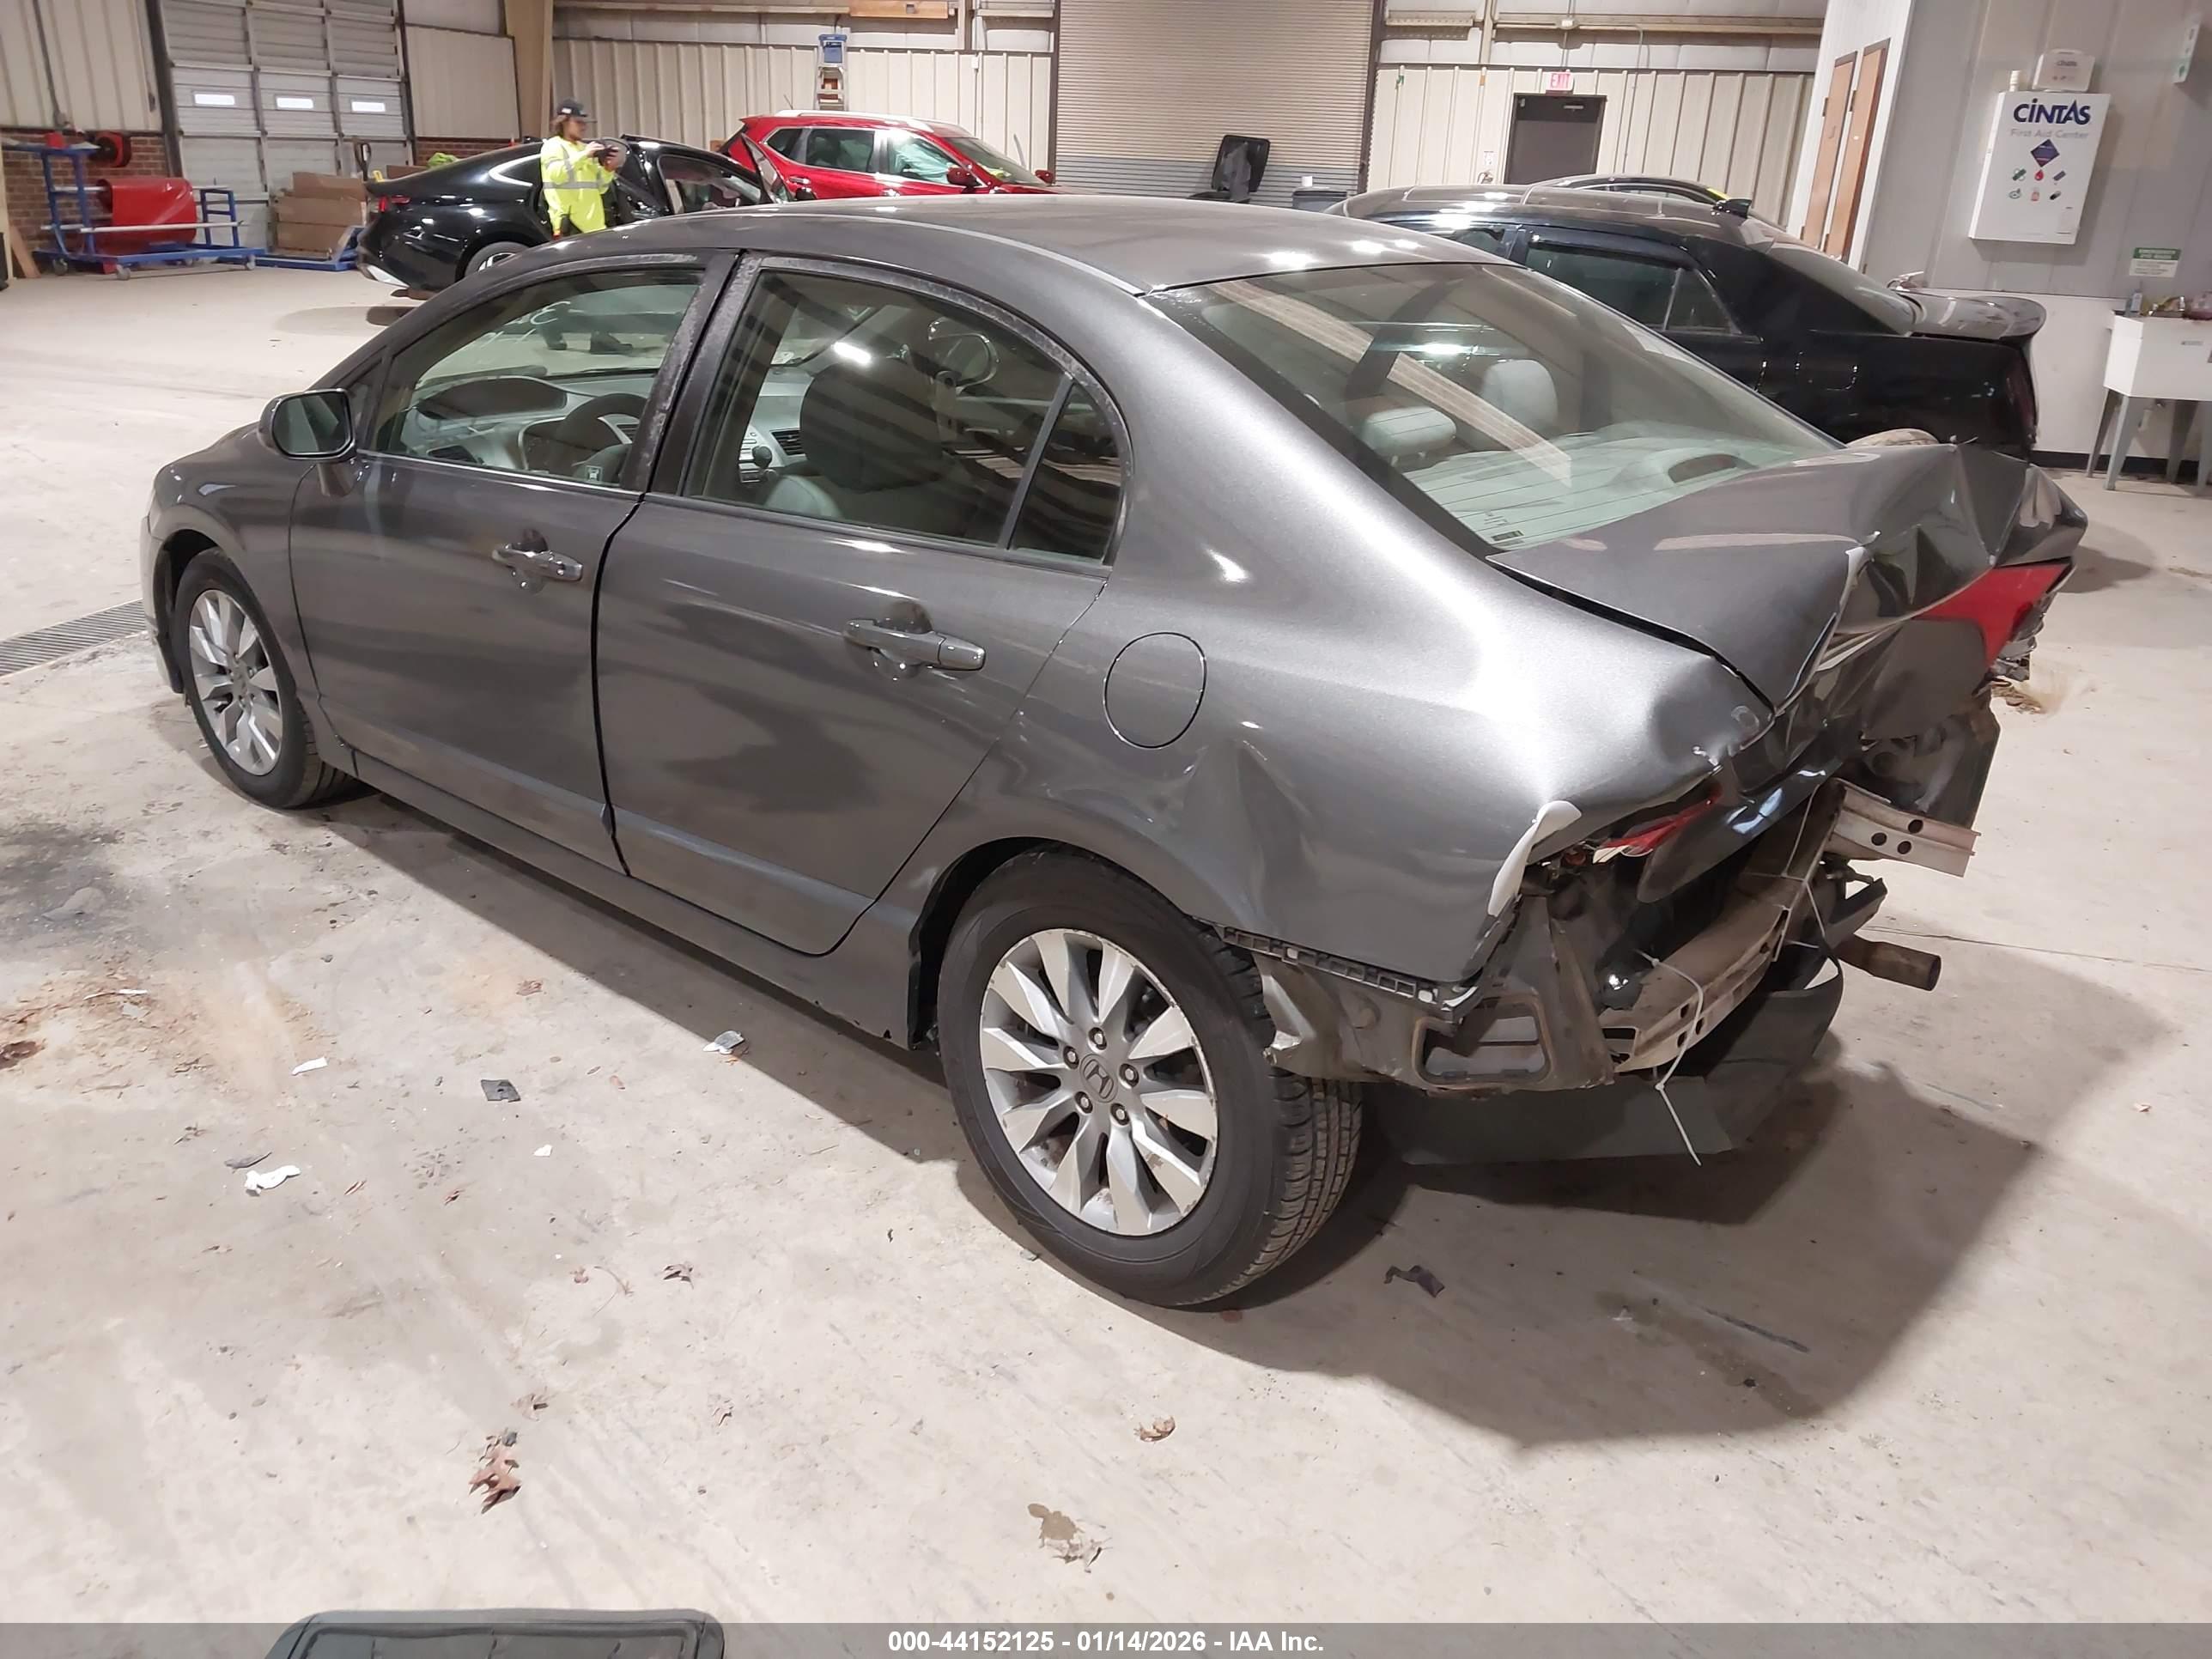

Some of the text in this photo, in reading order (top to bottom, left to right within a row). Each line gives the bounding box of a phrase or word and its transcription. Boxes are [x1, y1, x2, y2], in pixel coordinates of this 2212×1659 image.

[2011, 128, 2089, 139] First Aid Center
